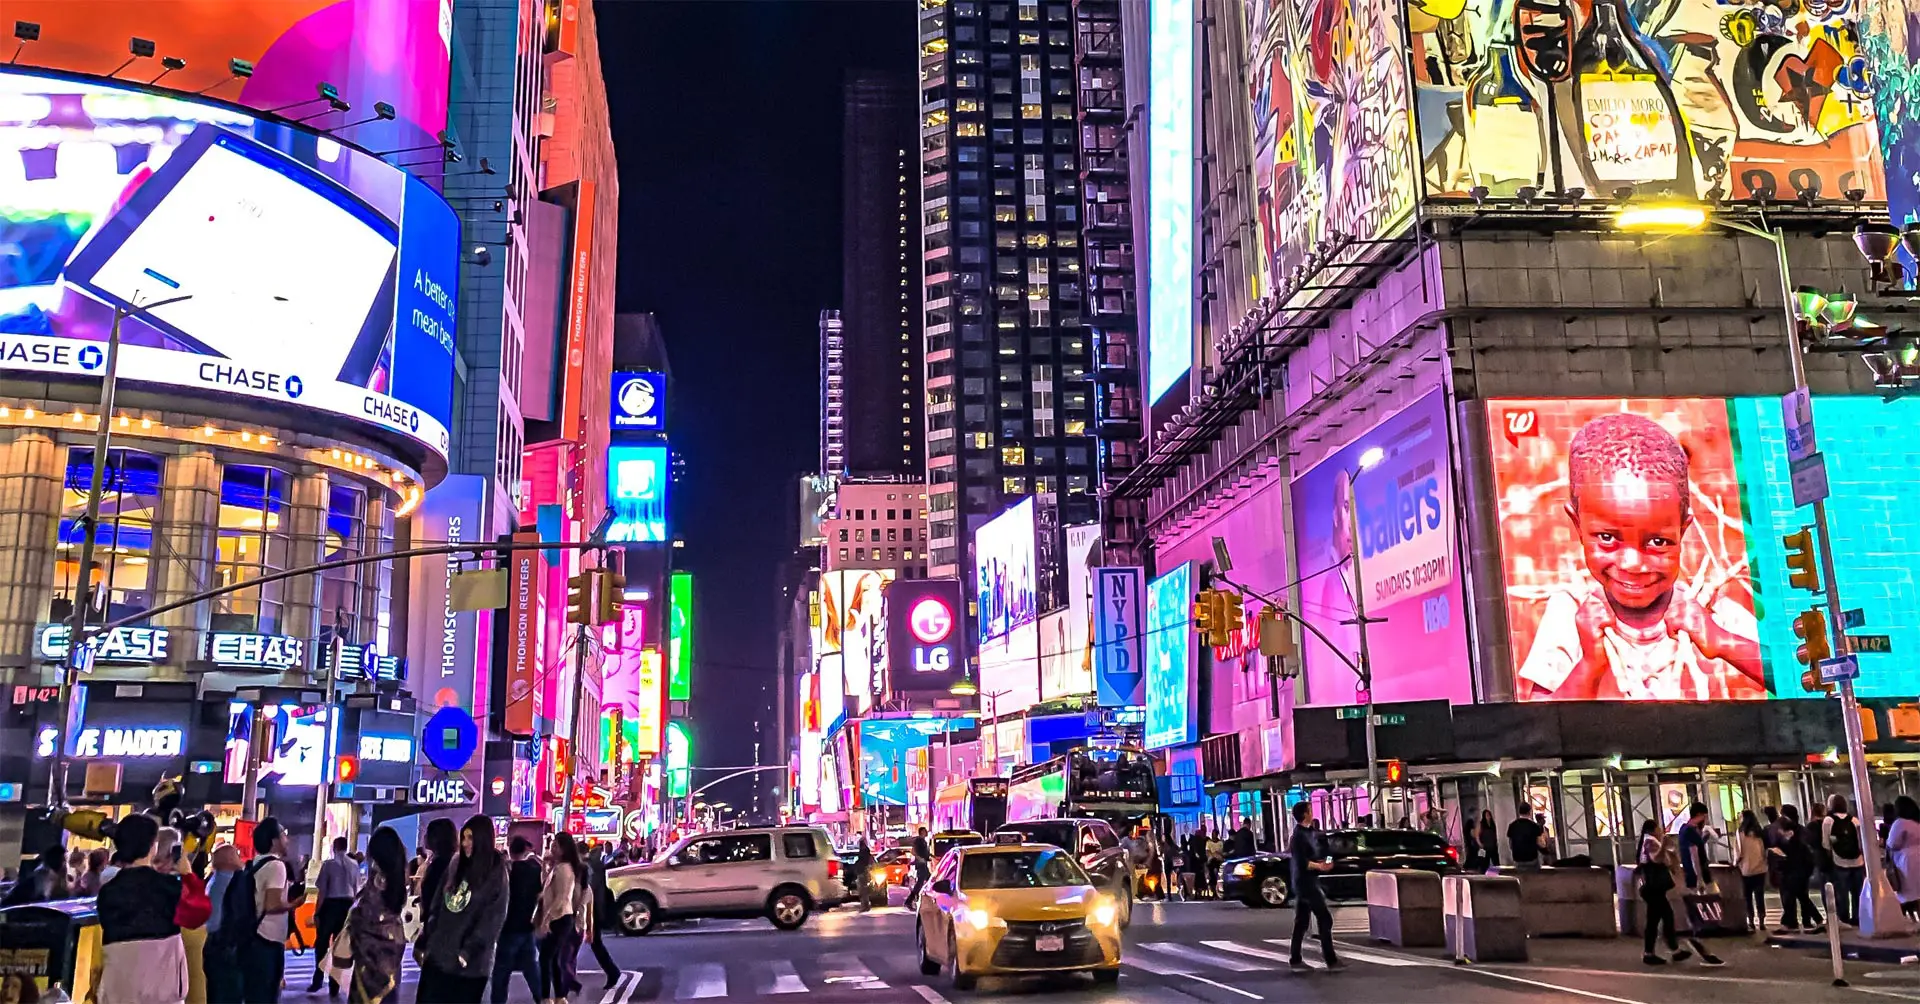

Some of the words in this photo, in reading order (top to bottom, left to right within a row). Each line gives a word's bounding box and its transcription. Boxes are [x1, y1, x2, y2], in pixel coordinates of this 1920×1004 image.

[1587, 98, 1626, 112] EMILIO
[578, 250, 588, 293] REUTERS
[413, 268, 423, 292] A
[424, 272, 448, 310] better
[412, 308, 439, 340] mean
[574, 295, 584, 342] THOMSON
[199, 362, 281, 393] CHASE
[363, 396, 409, 426] CHASE
[1358, 477, 1441, 560] ballers
[1070, 531, 1086, 547] GAP
[519, 558, 531, 610] REUTERS
[1375, 568, 1412, 602] SUNDAYS
[1412, 555, 1446, 590] 10:30PM
[1112, 575, 1130, 671] NYPD
[1422, 593, 1450, 635] HBO
[211, 633, 303, 666] CHASE
[516, 612, 528, 672] THOMSON
[1870, 636, 1881, 651] 42
[915, 647, 950, 672] LG
[28, 688, 37, 702] W
[37, 687, 50, 702] 42
[102, 728, 182, 757] MADDEN
[416, 779, 464, 803] CHASE
[1696, 902, 1722, 920] GAP
